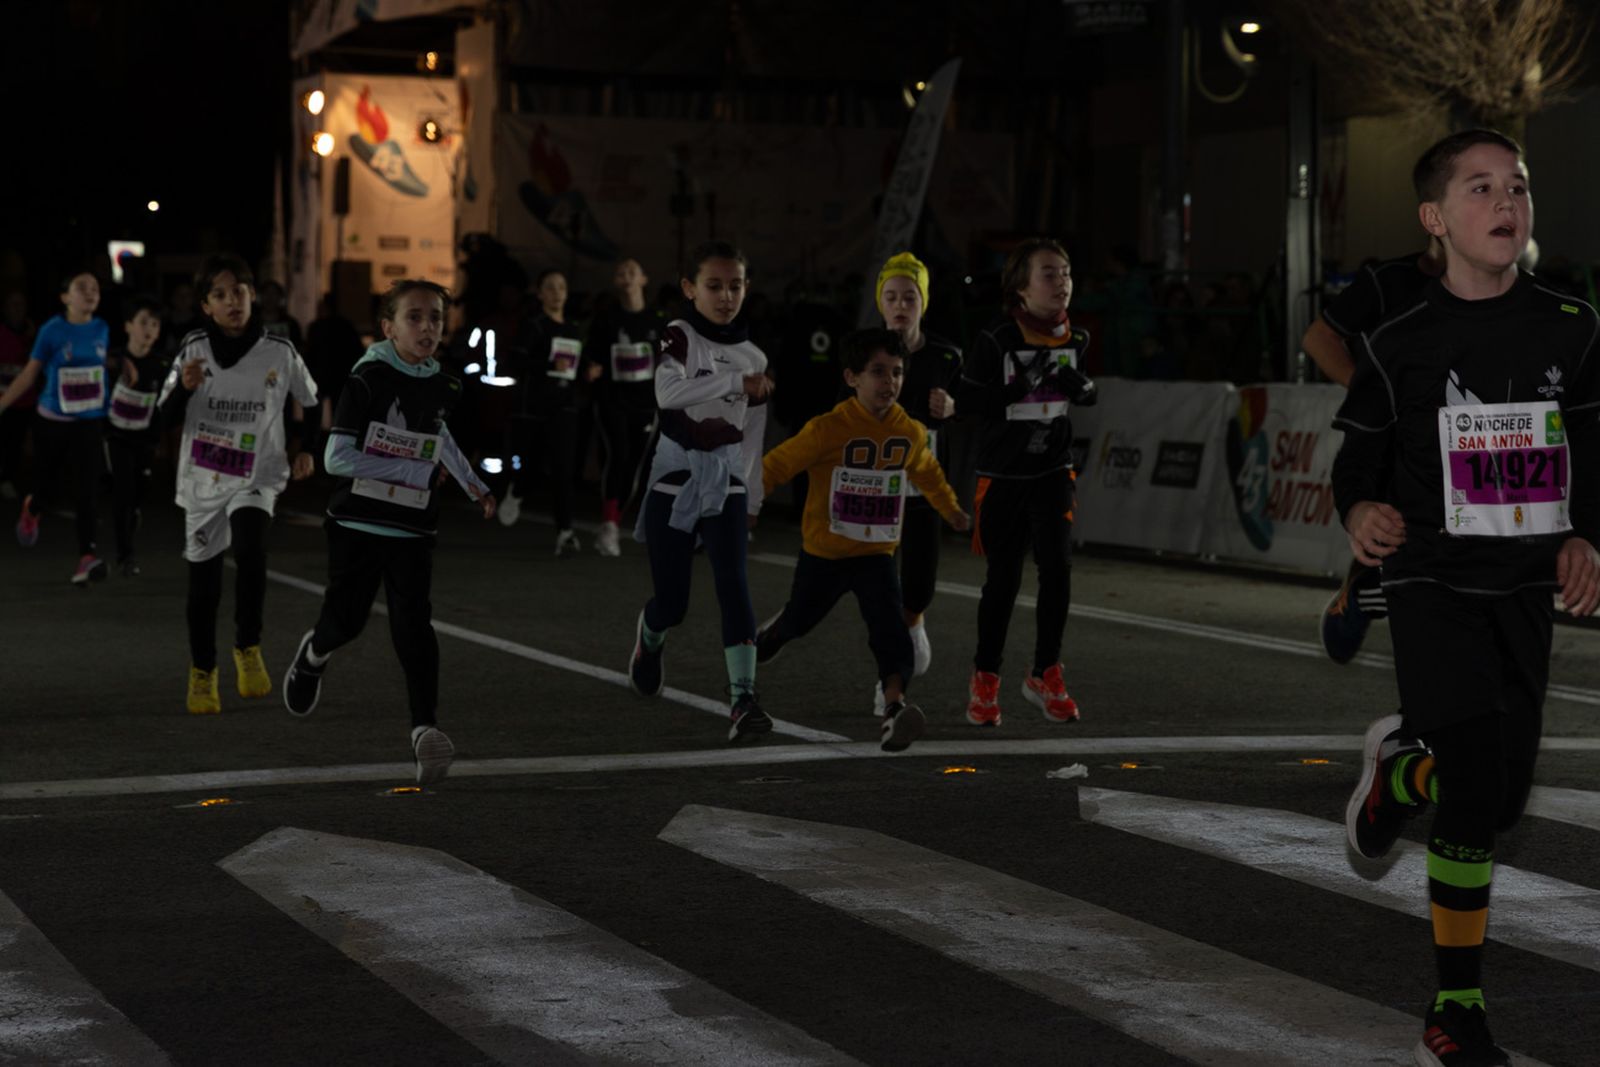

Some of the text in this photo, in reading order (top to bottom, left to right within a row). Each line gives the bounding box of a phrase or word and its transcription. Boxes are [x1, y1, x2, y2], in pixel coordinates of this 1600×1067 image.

[209, 397, 266, 412] Emirates
[1474, 417, 1533, 432] NOCHE DE
[1458, 435, 1486, 449] SAN
[1491, 431, 1533, 448] ANTÓN
[1271, 430, 1319, 473] SAN
[1466, 451, 1560, 490] 14921
